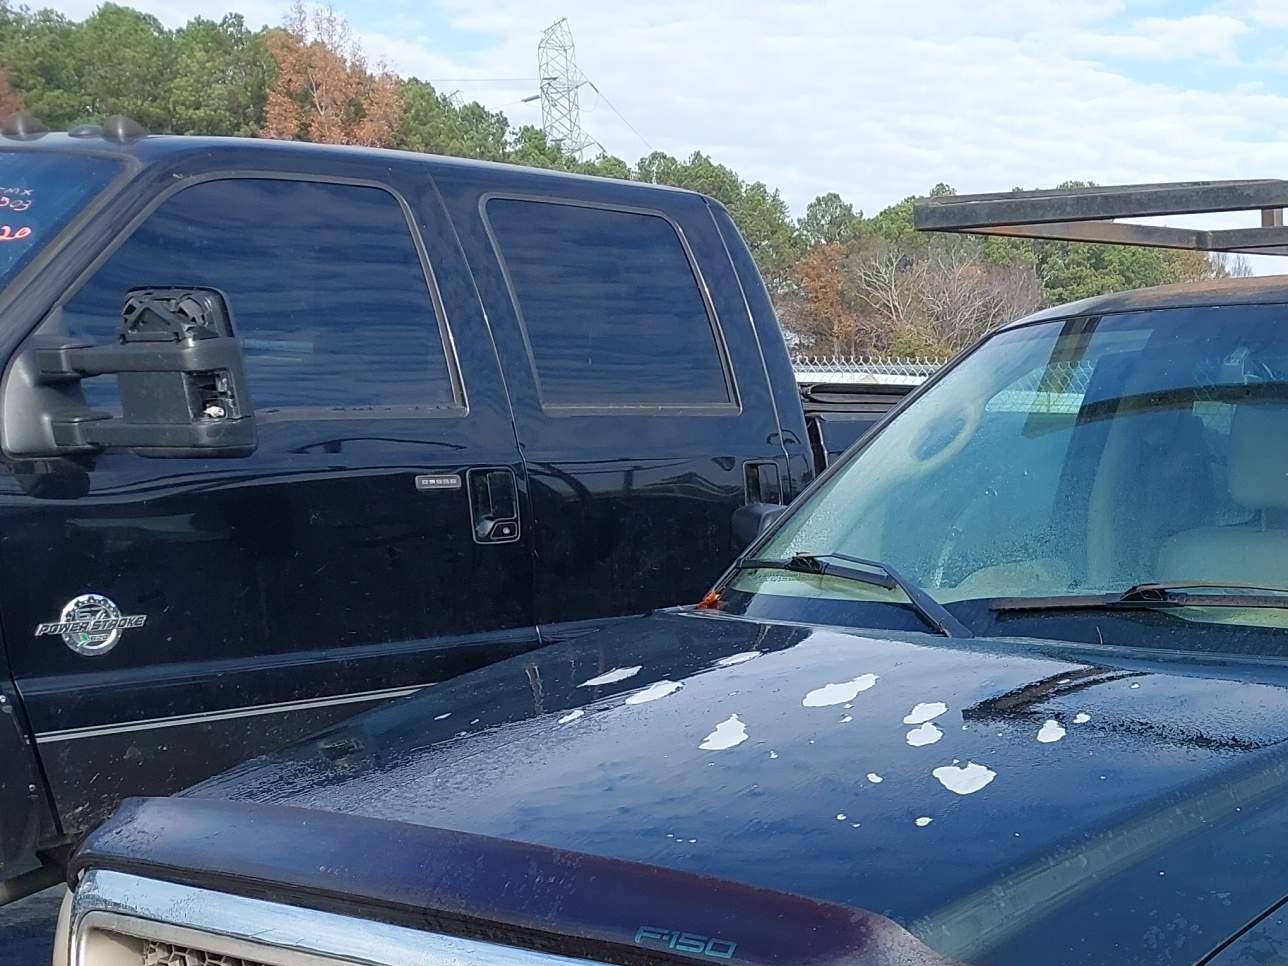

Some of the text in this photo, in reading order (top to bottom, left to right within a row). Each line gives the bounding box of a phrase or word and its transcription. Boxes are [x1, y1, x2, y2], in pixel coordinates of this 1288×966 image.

[35, 614, 148, 636] POWER STROKE
[634, 926, 737, 959] F-150
